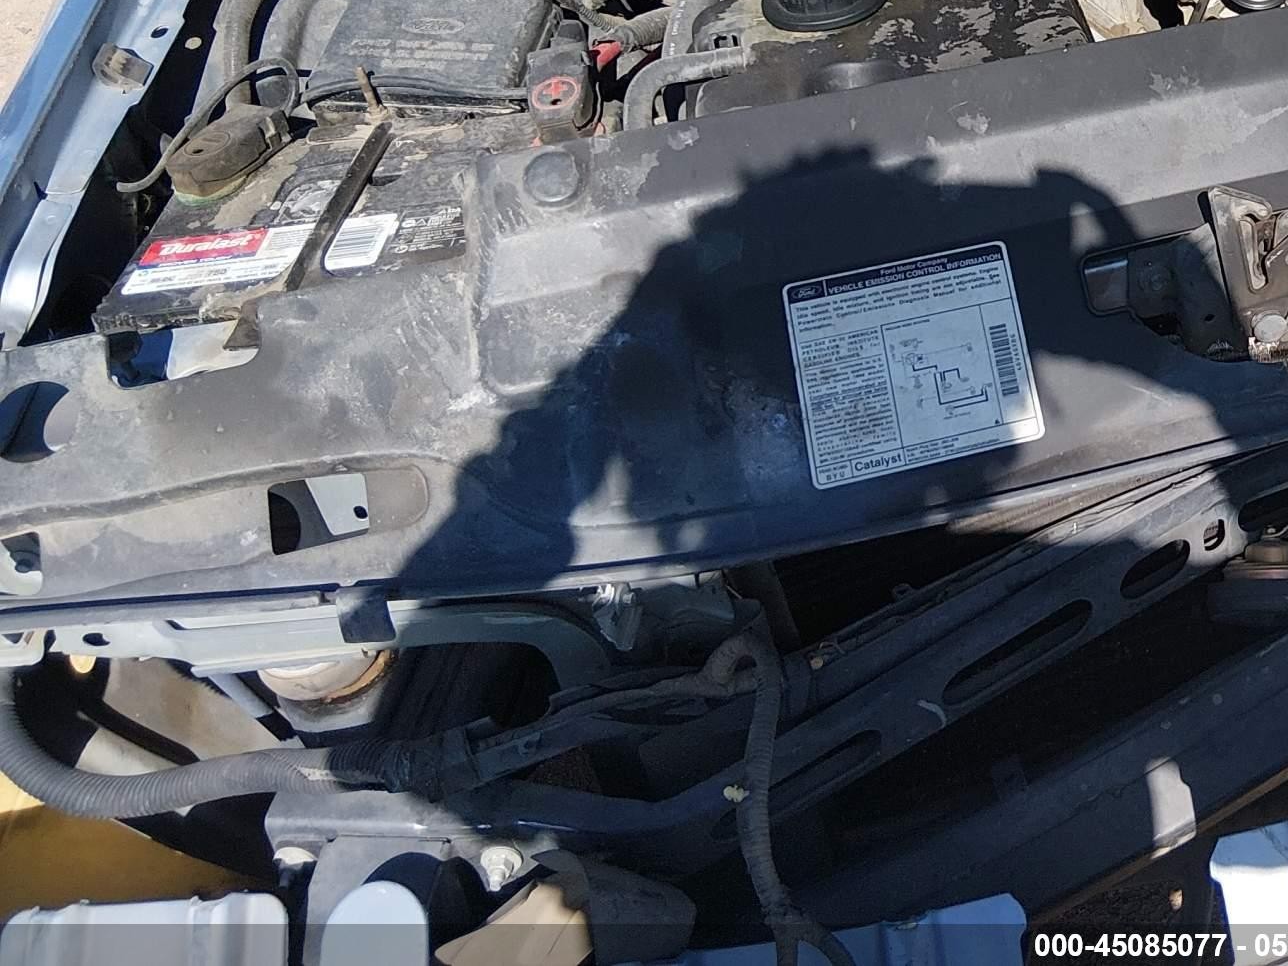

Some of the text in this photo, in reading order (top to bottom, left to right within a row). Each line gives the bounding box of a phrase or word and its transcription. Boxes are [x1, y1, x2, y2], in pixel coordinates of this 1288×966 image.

[160, 235, 251, 255] Duralast
[828, 251, 1001, 295] VEHICLE EMISSION CONTROL INFORMATION
[880, 266, 896, 275] Ford
[896, 263, 916, 272] Motor
[917, 256, 947, 269] Company
[853, 451, 902, 474] Catalyst
